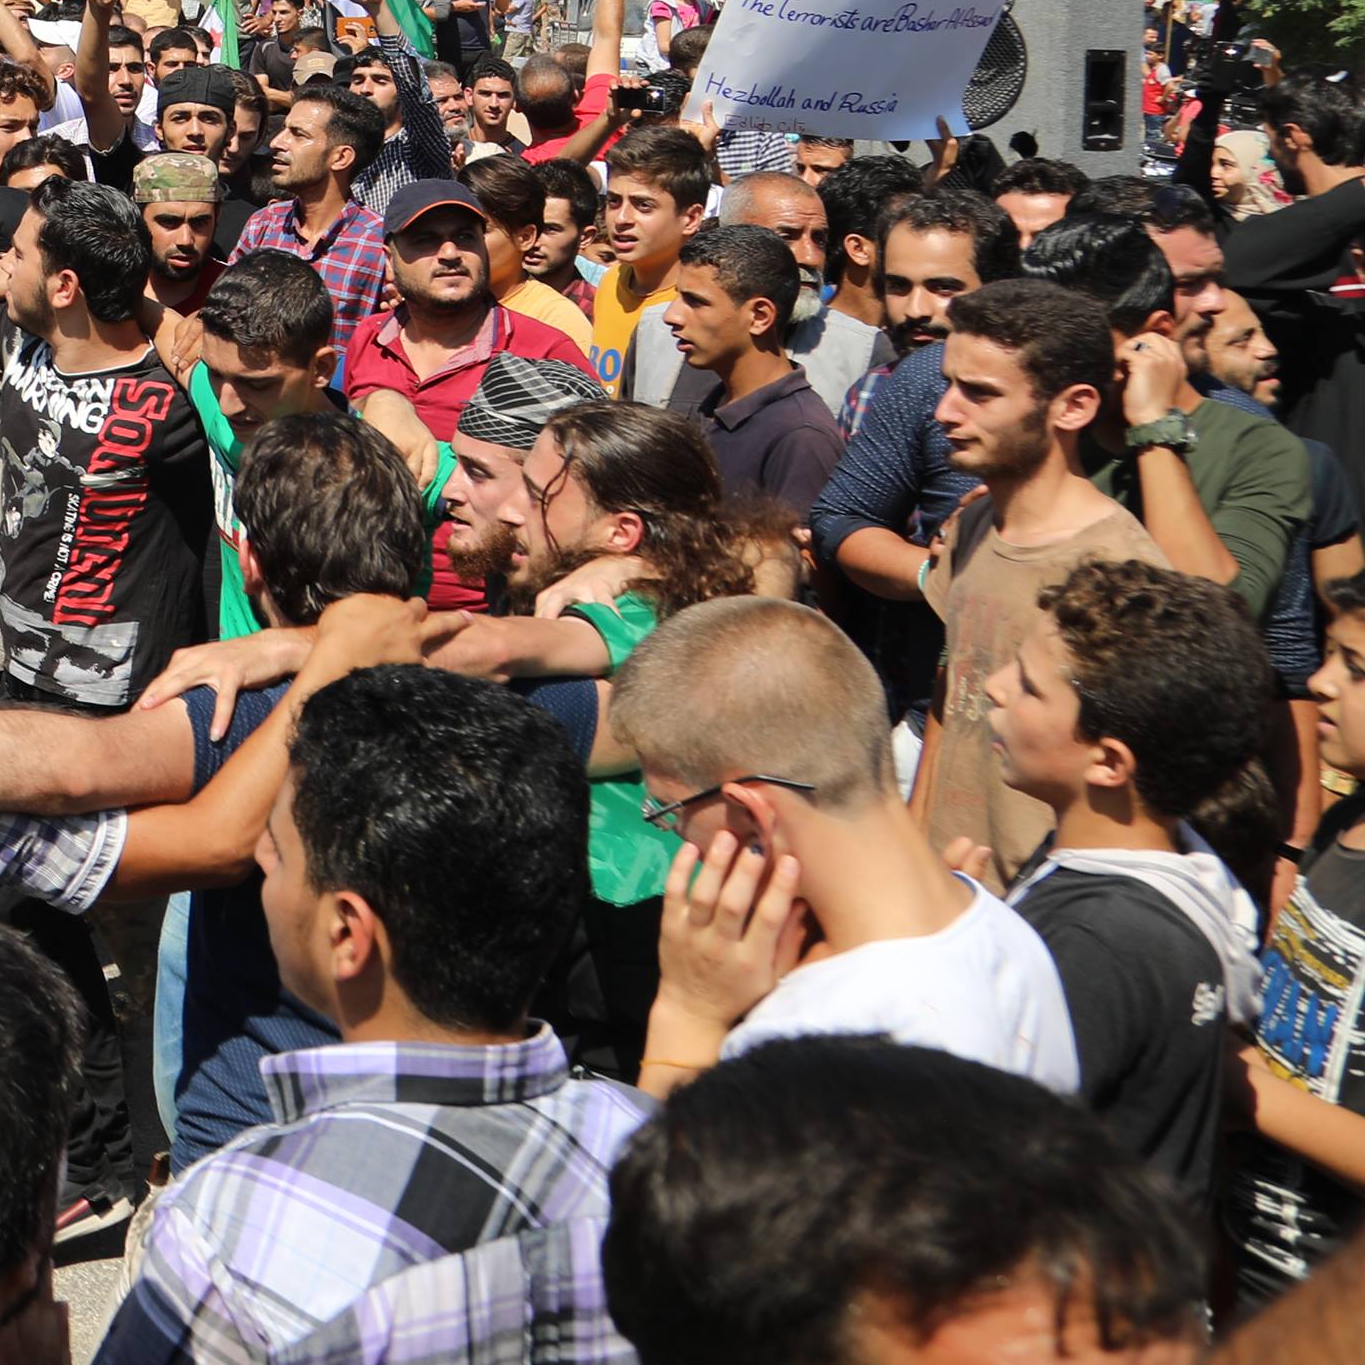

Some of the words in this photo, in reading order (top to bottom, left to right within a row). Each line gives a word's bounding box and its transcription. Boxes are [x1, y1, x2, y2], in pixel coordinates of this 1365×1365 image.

[861, 16, 895, 33] are
[705, 72, 796, 109] Hezbollah
[802, 91, 837, 112] and
[838, 91, 899, 115] Russia
